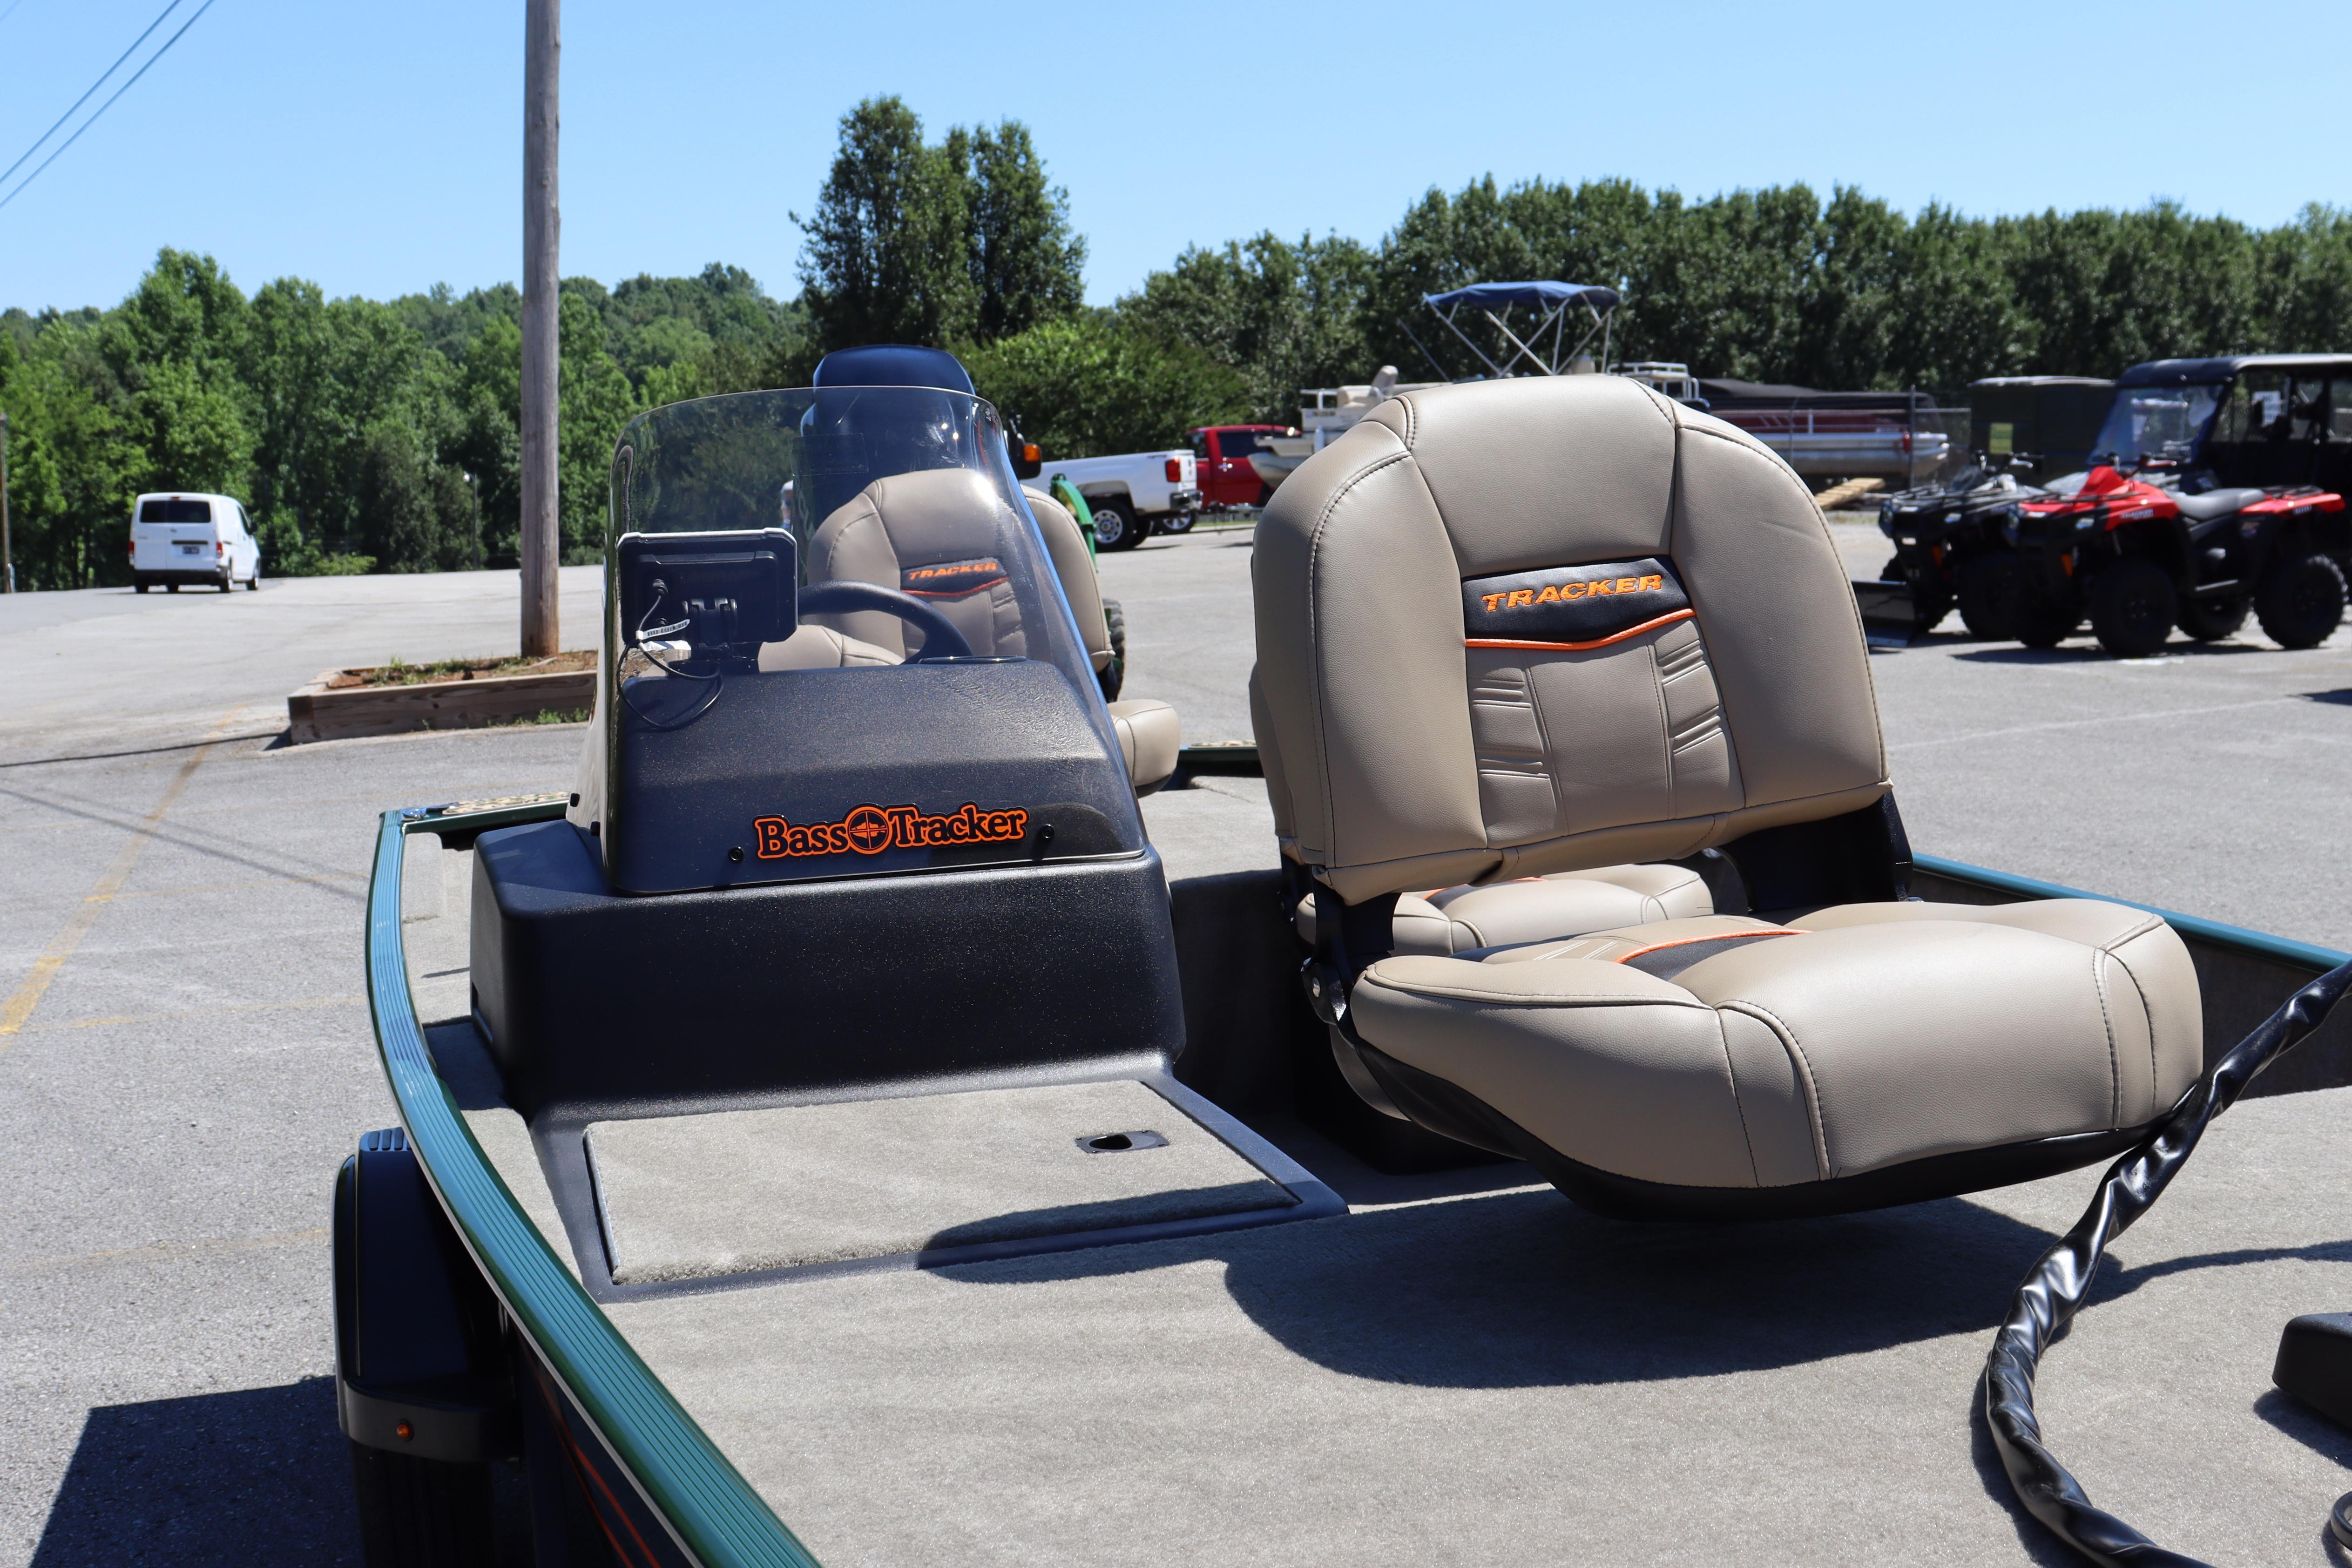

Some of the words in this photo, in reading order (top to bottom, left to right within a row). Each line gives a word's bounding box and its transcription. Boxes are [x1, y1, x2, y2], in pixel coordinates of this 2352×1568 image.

[909, 562, 998, 581] TRACKER
[1482, 574, 1663, 611] TRACKER
[755, 817, 848, 859] Bass
[886, 804, 1027, 847] Tracker
